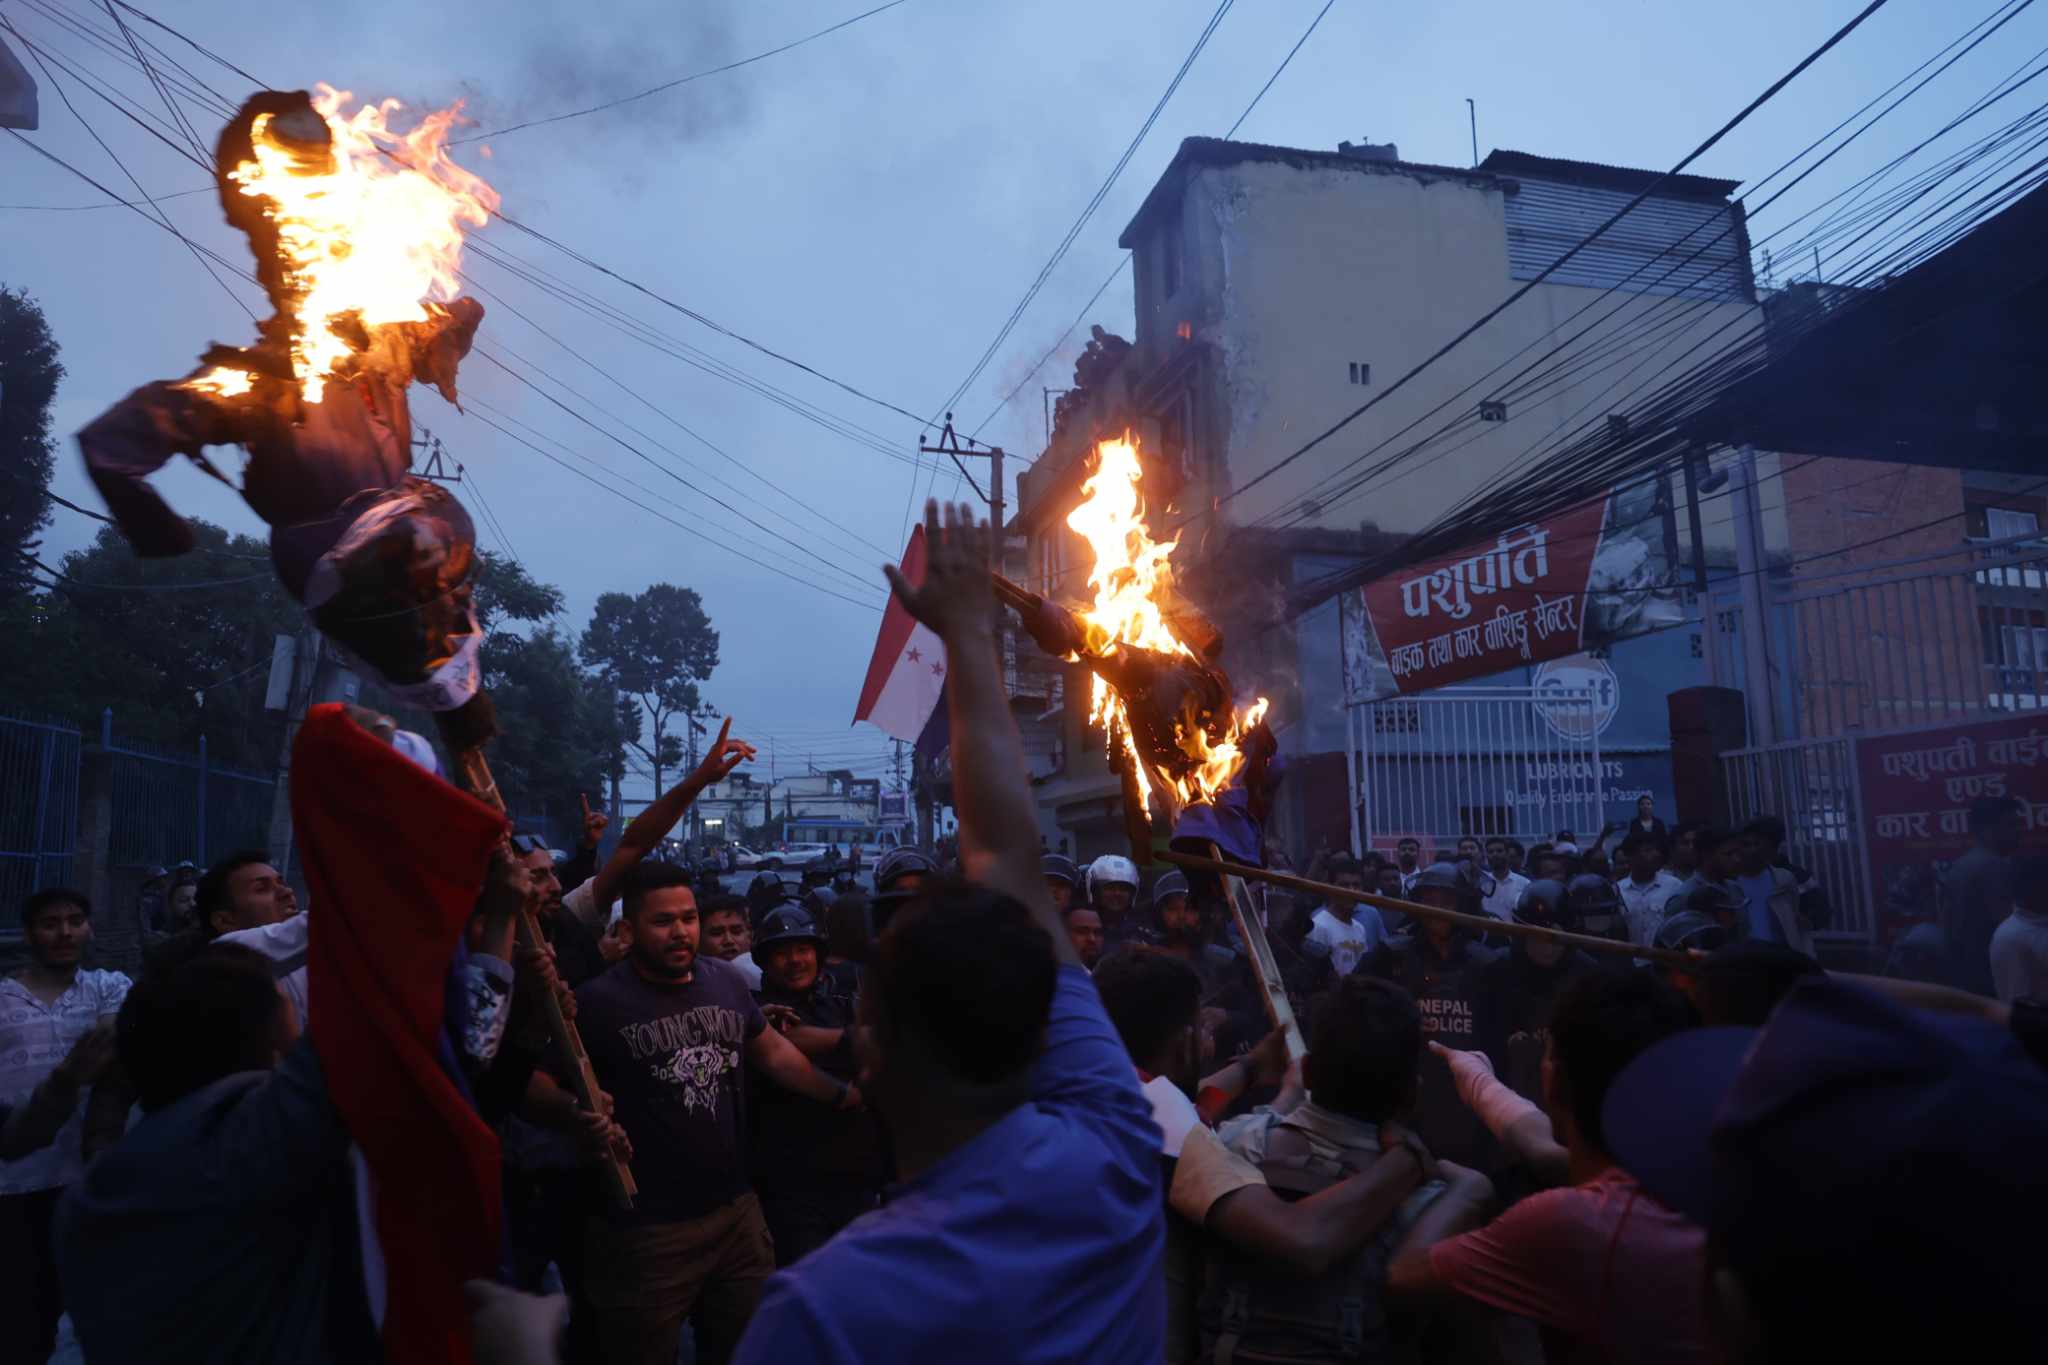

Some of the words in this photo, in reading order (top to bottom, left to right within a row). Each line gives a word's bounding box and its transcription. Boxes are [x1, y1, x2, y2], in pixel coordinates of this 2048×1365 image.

[1400, 521, 1551, 620] पशुपति
[1427, 633, 1453, 669] तथा
[1453, 624, 1484, 657] कार
[1532, 593, 1578, 640] सेन्टर
[1880, 735, 1977, 783] पशुपती
[1550, 787, 1609, 804] Endurane
[1875, 811, 1932, 838] कार
[1419, 999, 1473, 1016] NEPAL
[1422, 1016, 1473, 1034] POLICE
